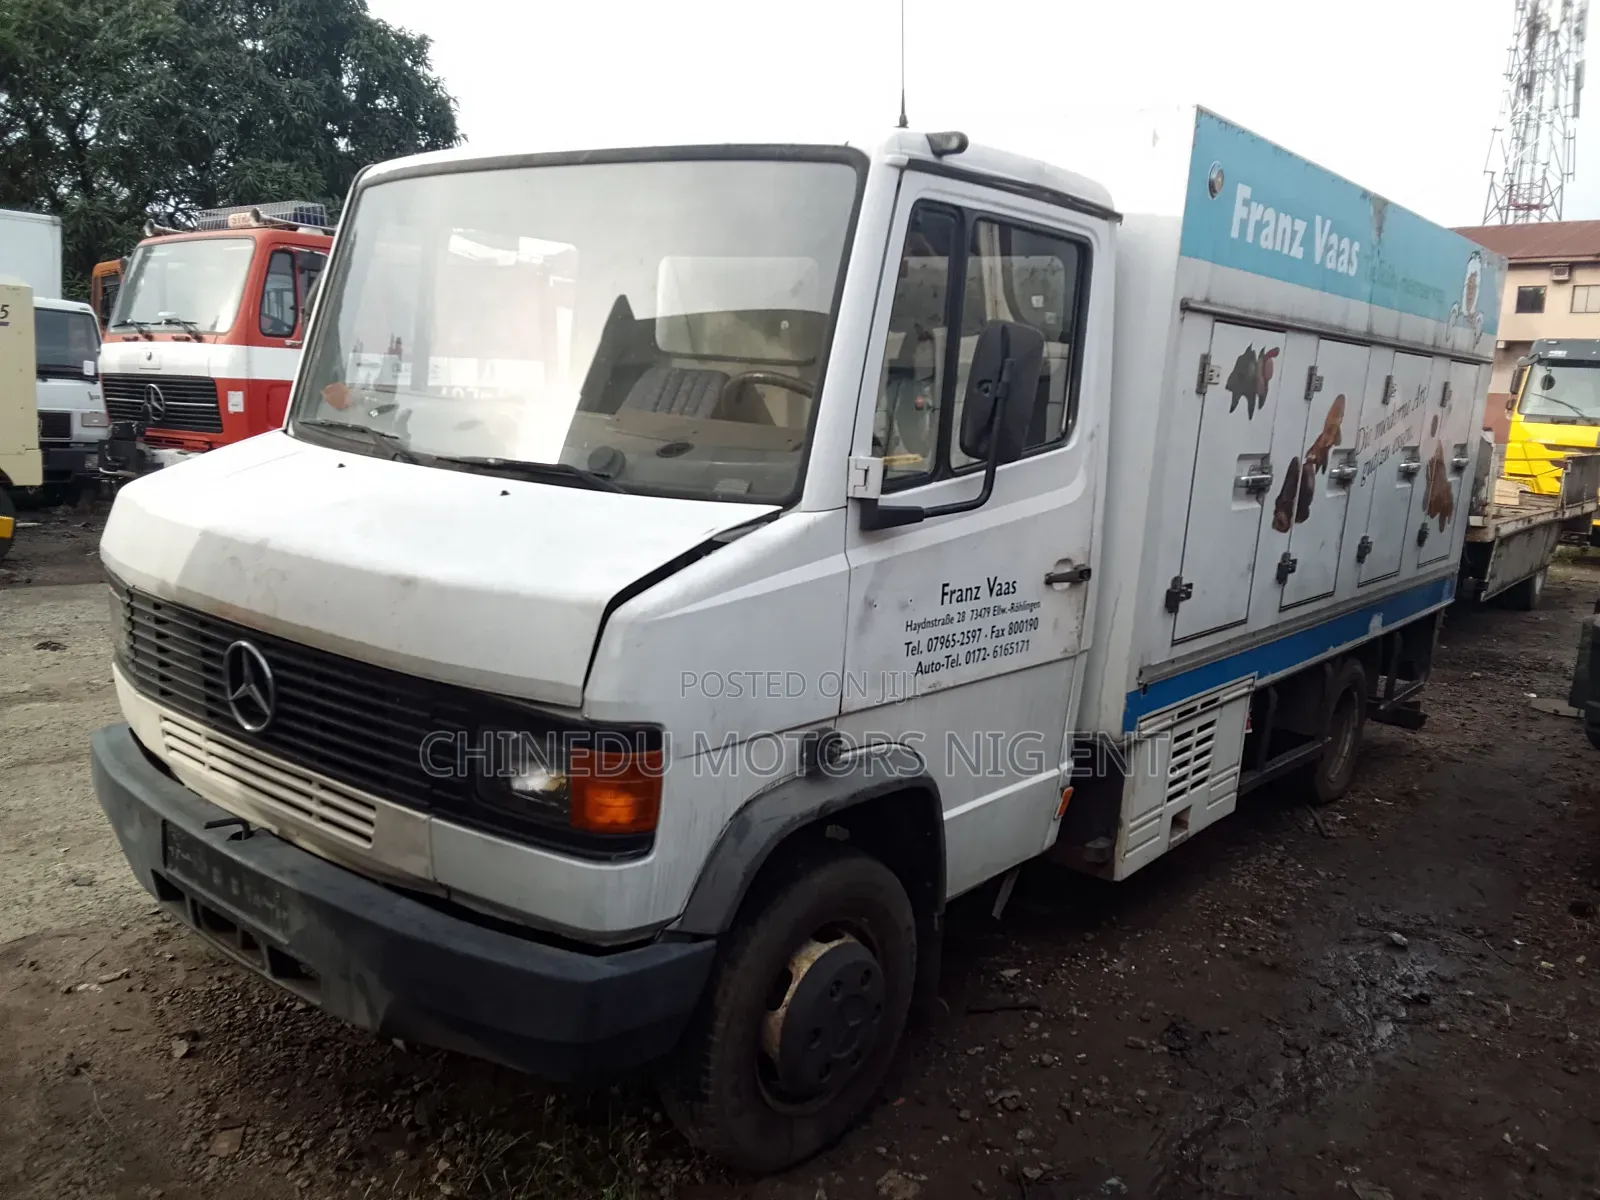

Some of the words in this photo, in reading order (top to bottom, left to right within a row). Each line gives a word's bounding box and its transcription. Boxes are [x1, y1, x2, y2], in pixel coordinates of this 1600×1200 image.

[1230, 182, 1308, 260] Franz
[1313, 214, 1361, 277] Vaas
[940, 582, 981, 605] Franz
[987, 576, 1017, 598] Vaas
[904, 640, 923, 657] Tel.
[927, 628, 982, 653] 07965-2597
[990, 625, 1005, 640] Fax
[1008, 617, 1039, 636] 800190
[905, 614, 954, 634] Haydnstraße
[957, 612, 966, 623] 28
[970, 607, 991, 621] 73479
[915, 655, 962, 676] Auto-Tel.
[992, 639, 1030, 659] 6165171
